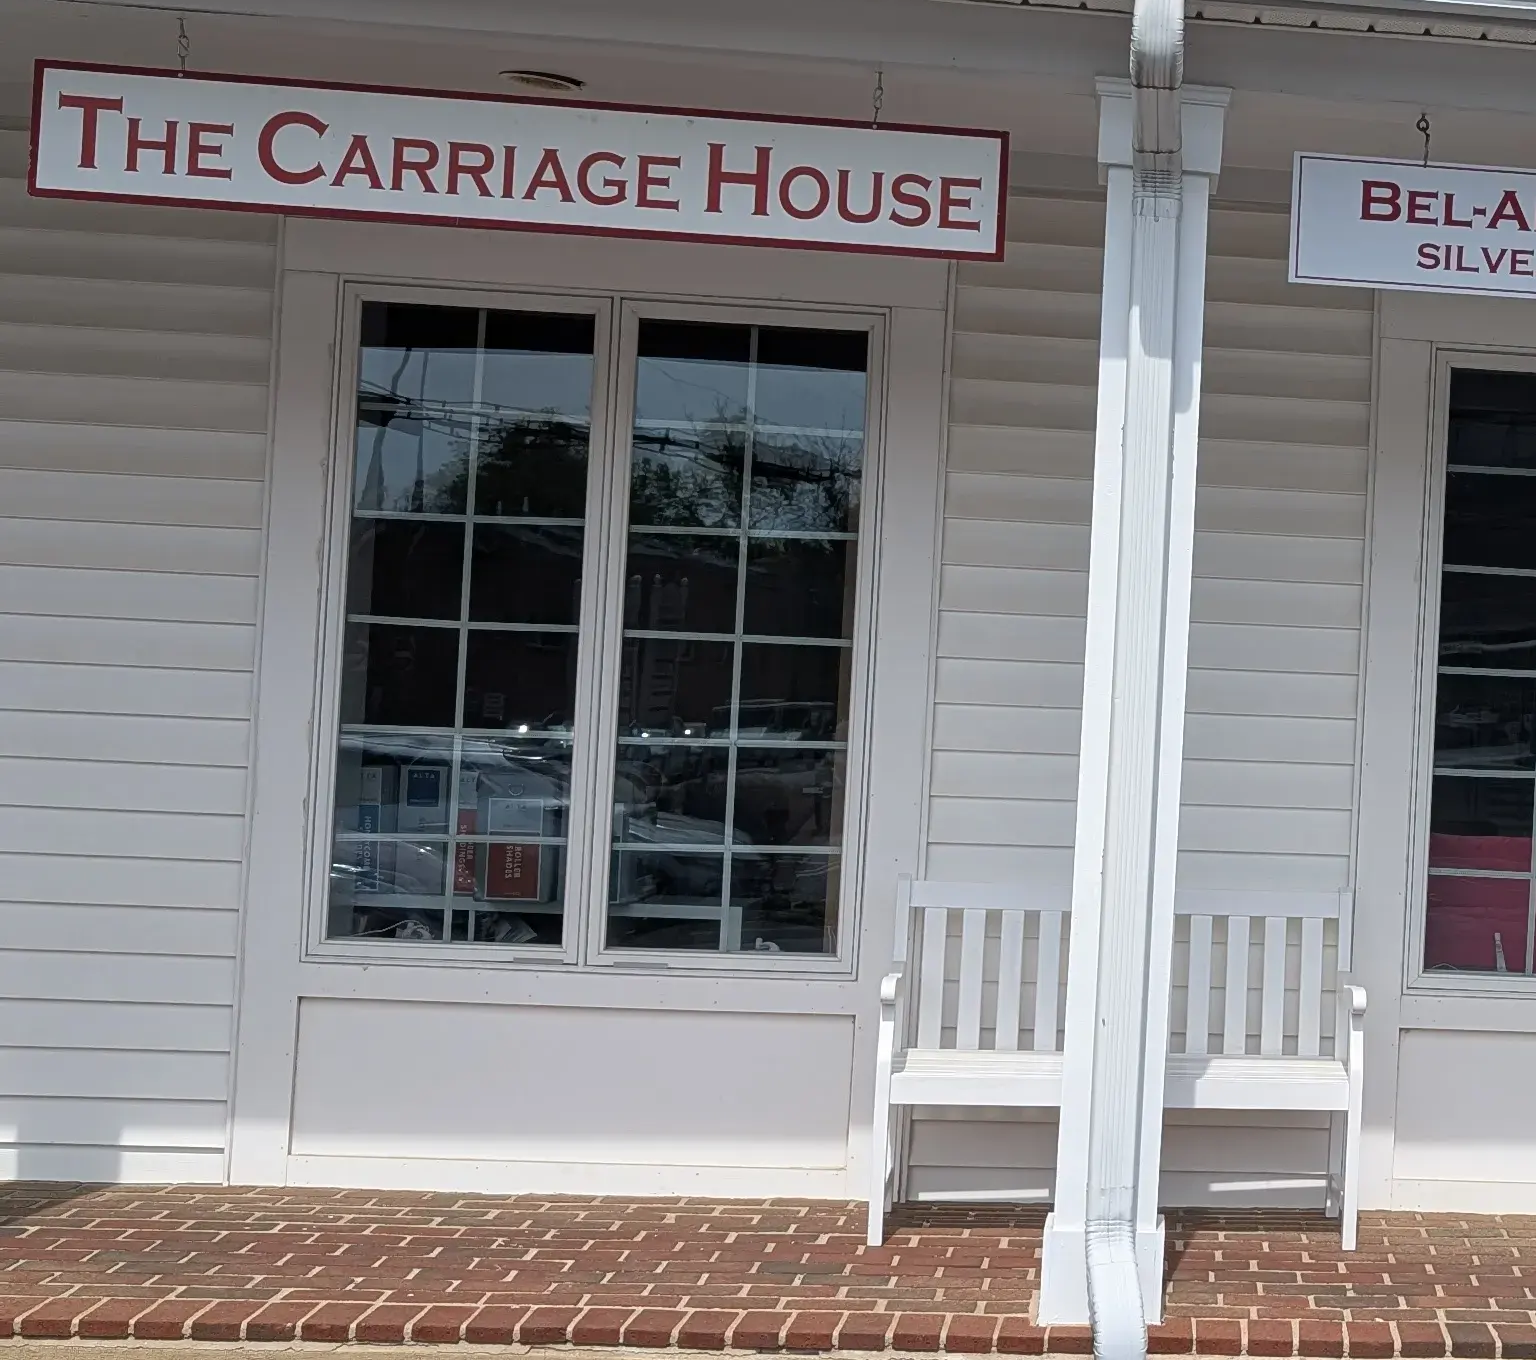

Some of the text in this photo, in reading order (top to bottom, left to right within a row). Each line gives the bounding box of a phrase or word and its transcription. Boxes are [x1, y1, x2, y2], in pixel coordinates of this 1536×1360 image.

[57, 92, 983, 234] THE CARRIAGE HOUSE
